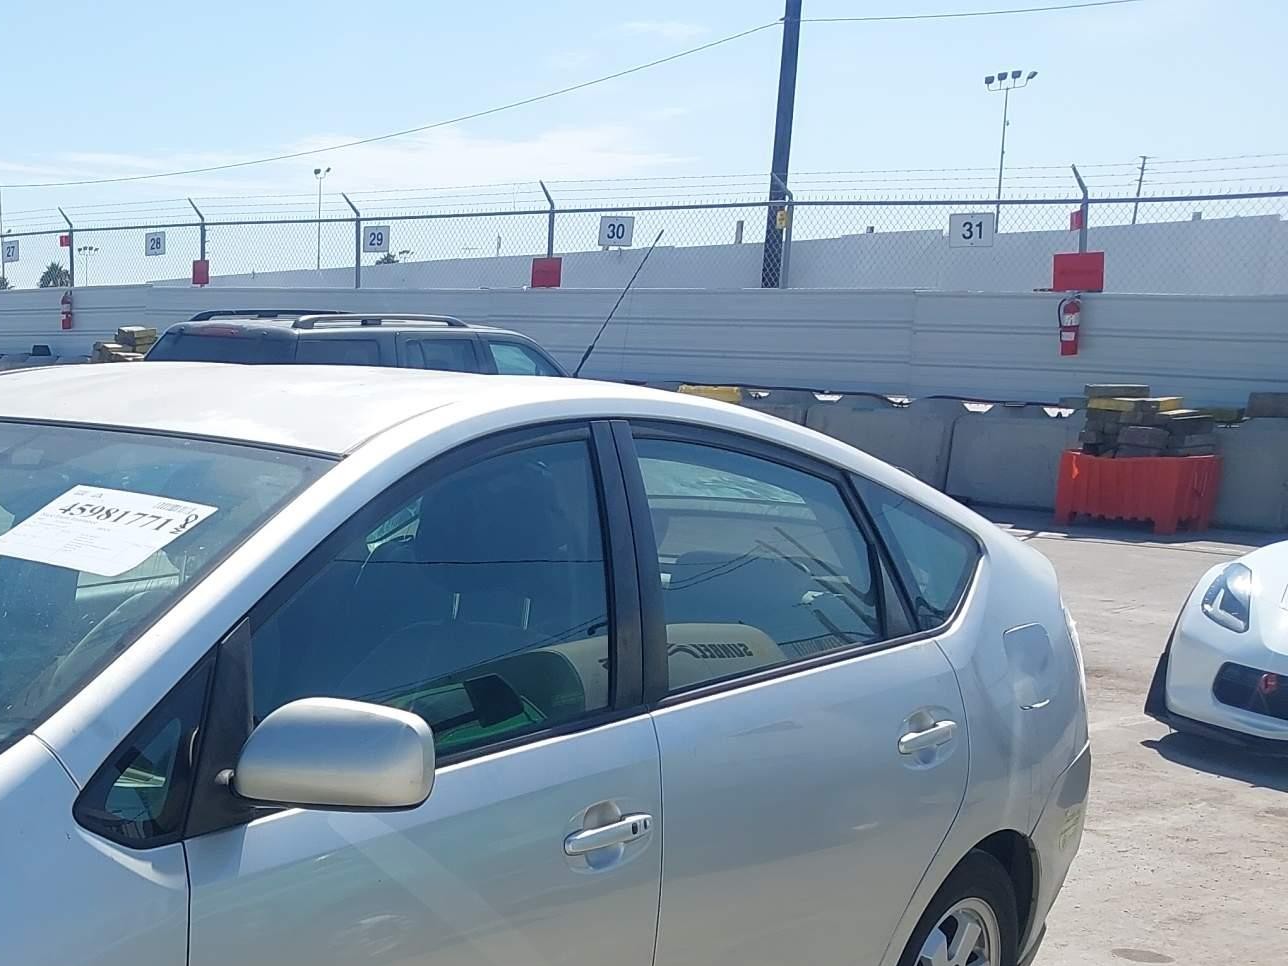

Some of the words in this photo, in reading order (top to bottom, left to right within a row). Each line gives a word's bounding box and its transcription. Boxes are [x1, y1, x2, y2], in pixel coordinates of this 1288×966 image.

[607, 223, 625, 240] 30
[962, 221, 983, 240] 31
[150, 237, 161, 250] 28
[369, 232, 384, 246] 29
[6, 246, 15, 257] 27
[58, 502, 175, 532] 45981771
